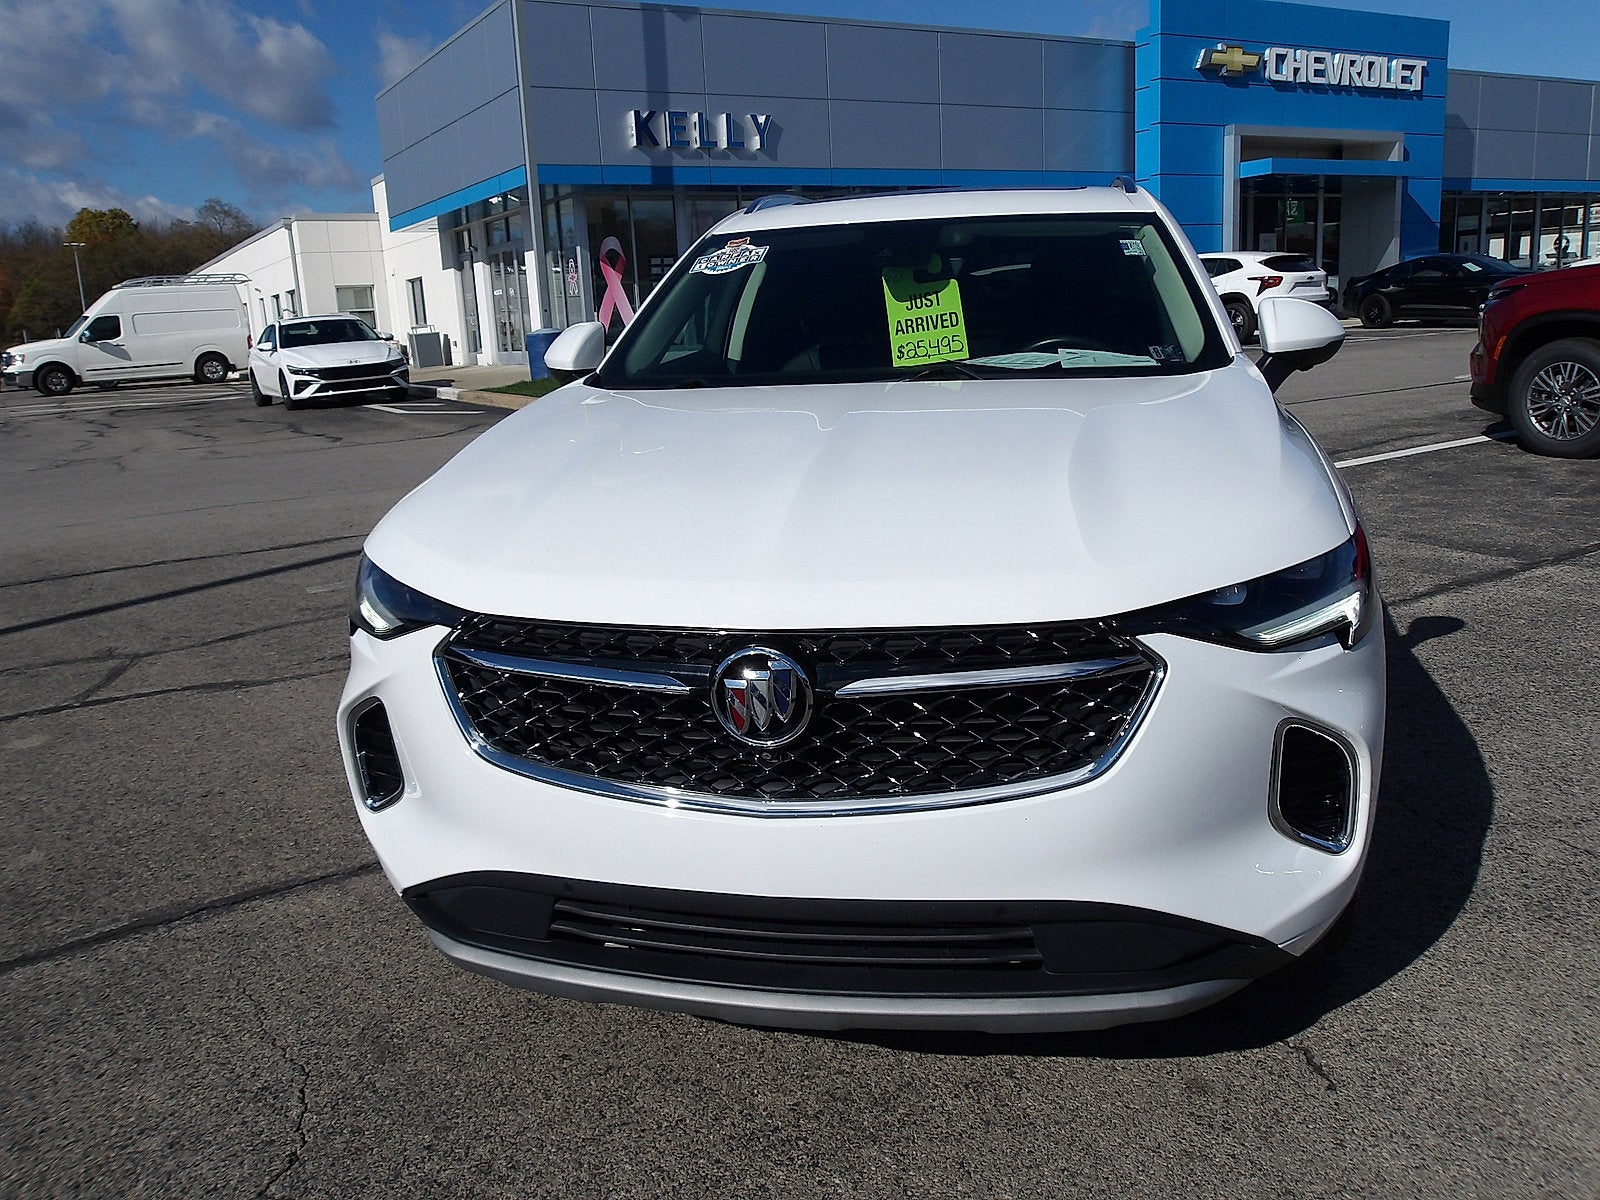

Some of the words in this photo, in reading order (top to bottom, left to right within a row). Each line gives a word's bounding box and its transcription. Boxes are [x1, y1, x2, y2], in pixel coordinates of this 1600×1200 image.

[1264, 47, 1427, 91] CHEVROLET
[631, 109, 773, 150] KELLY
[905, 290, 941, 311] JUST
[895, 311, 960, 336] ARRIVED
